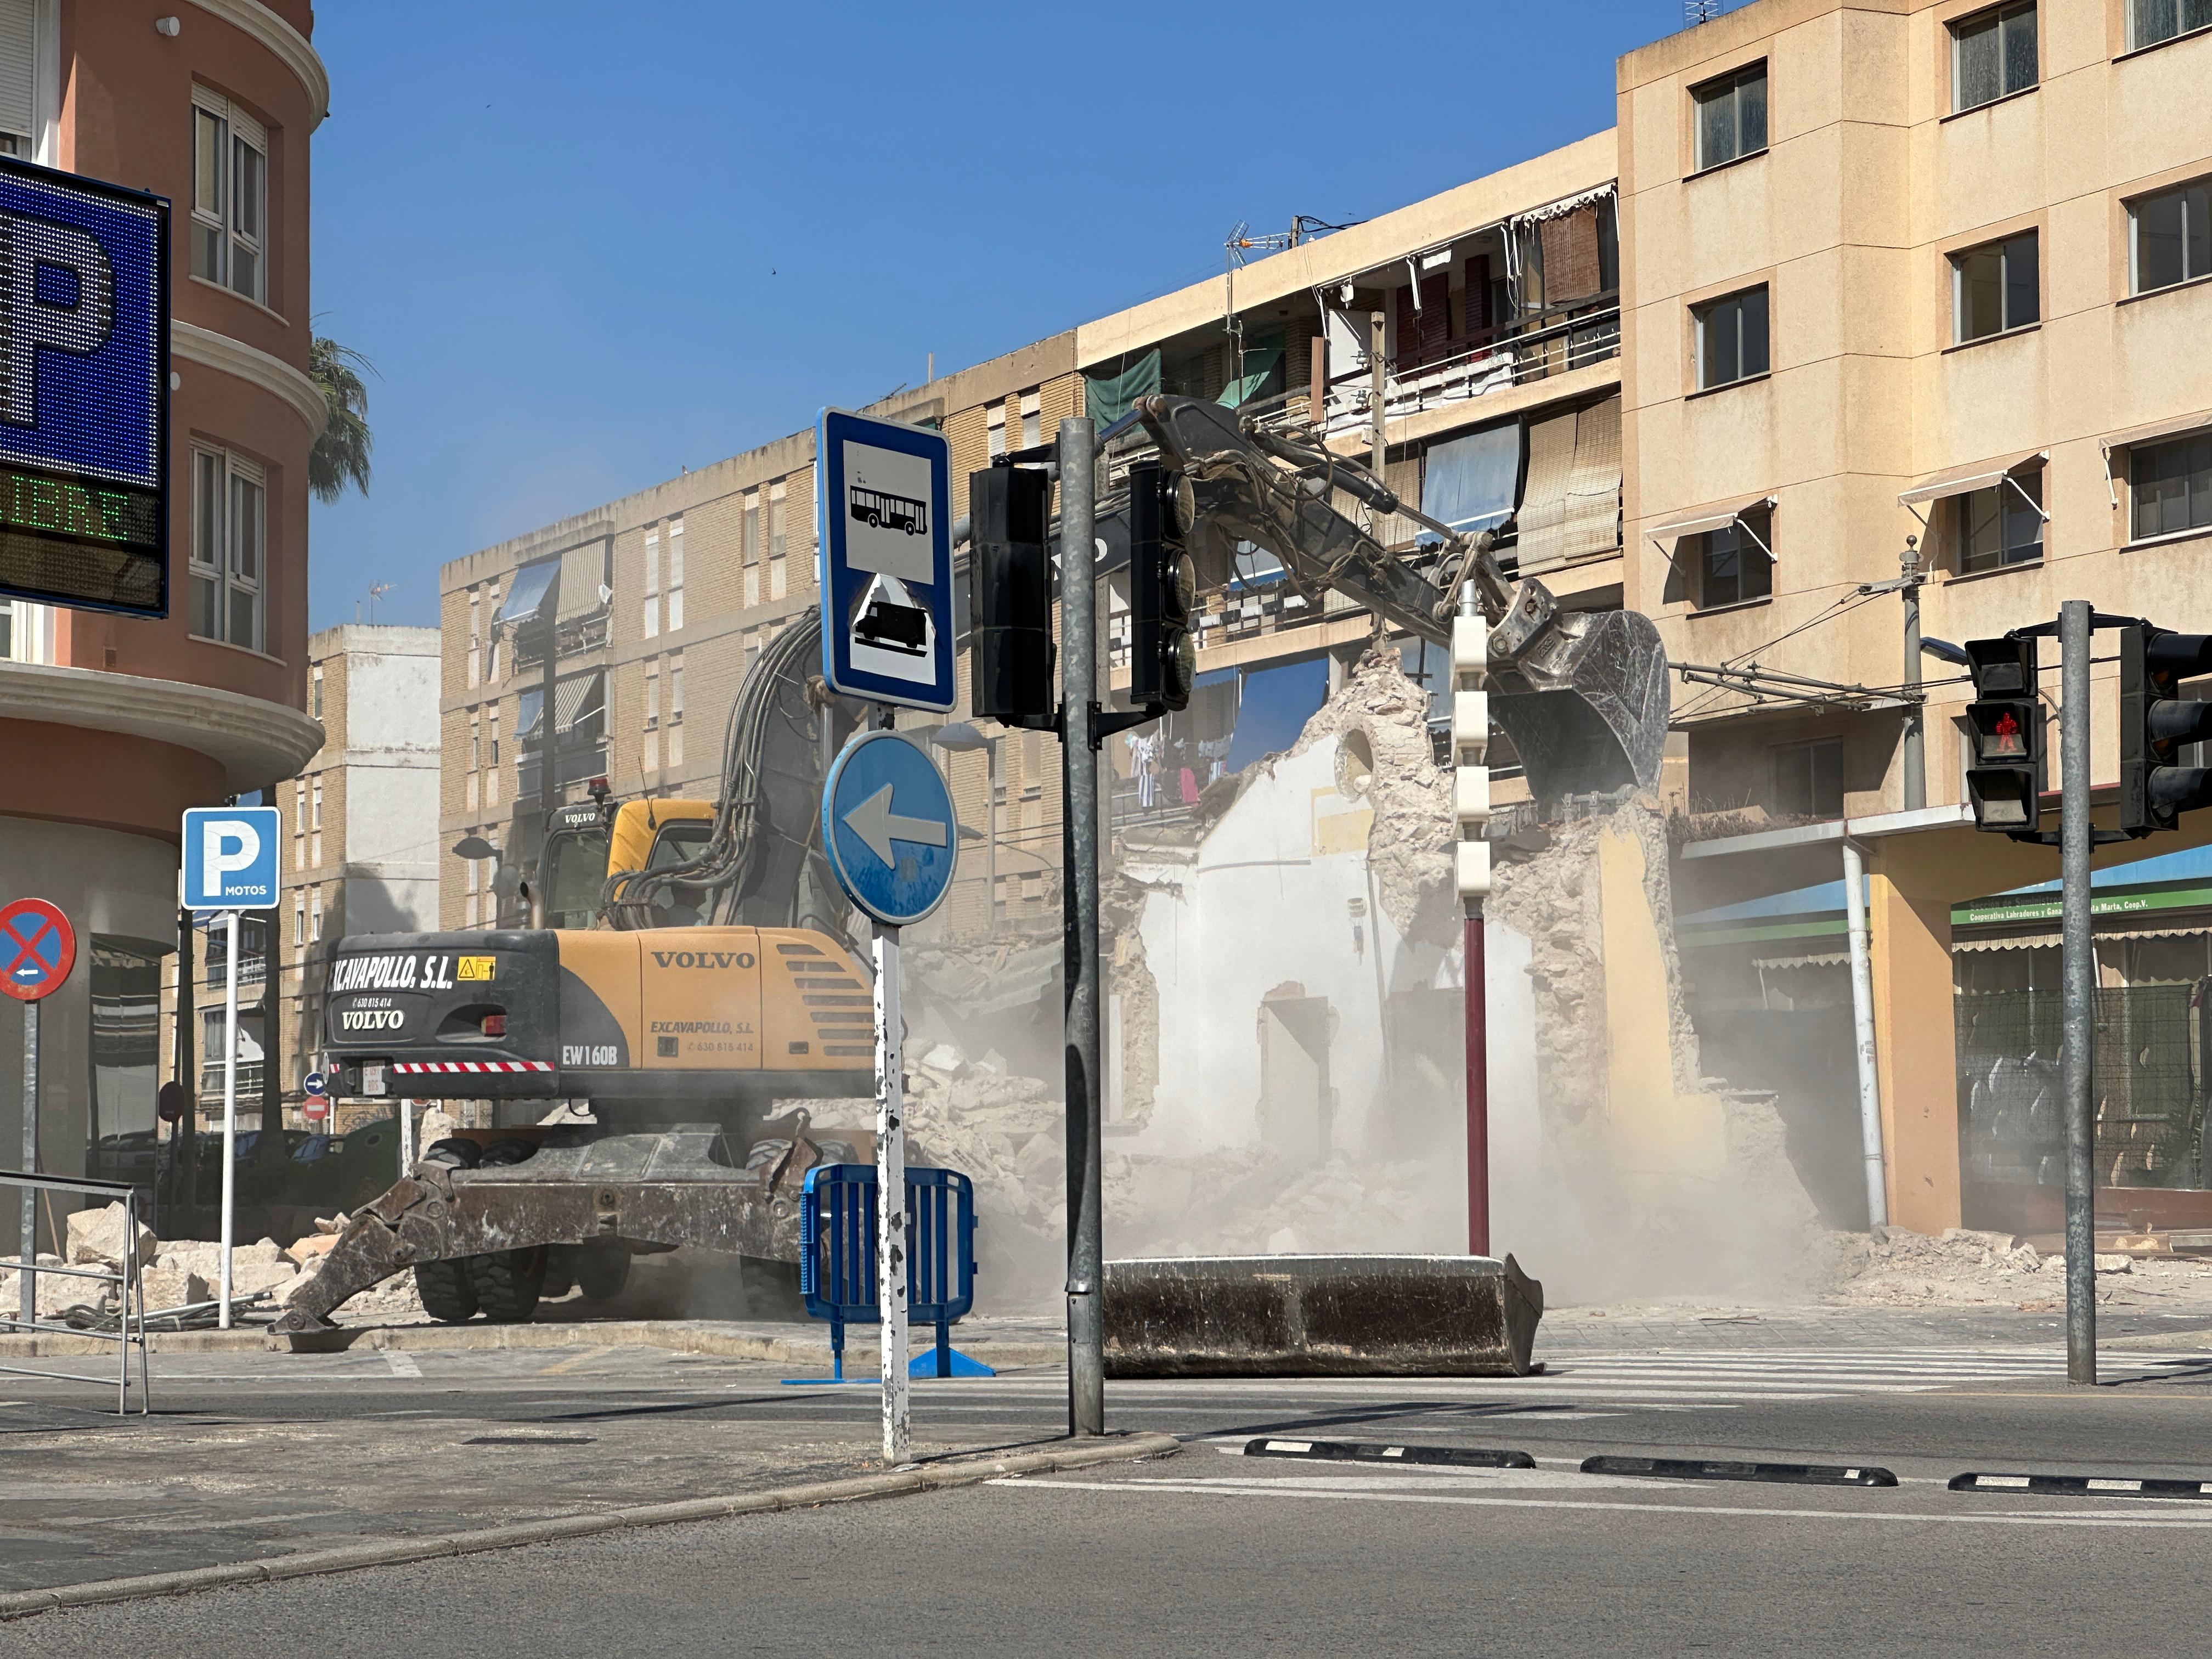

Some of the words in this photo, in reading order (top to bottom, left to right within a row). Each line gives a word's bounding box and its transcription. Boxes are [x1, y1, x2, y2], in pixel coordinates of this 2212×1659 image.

[0, 475, 128, 541] IBRE
[566, 812, 595, 823] VOLVO
[204, 821, 260, 896] P
[225, 885, 267, 896] MOTOS
[1970, 911, 2004, 922] Cooperativa
[2006, 909, 2039, 919] Labradores
[2101, 902, 2122, 911] Marta,
[2124, 900, 2148, 910] Coop.V.
[651, 951, 755, 969] VOLVO
[420, 956, 452, 989] S.L.
[357, 998, 368, 1008] 630
[368, 998, 379, 1008] 815
[380, 998, 392, 1008] 414
[342, 1010, 404, 1030] VOLVO
[650, 1022, 732, 1035] EXCAVAPOLLO,
[563, 1046, 617, 1065] EW160B
[697, 1042, 714, 1052] 630
[737, 1042, 753, 1052] 414
